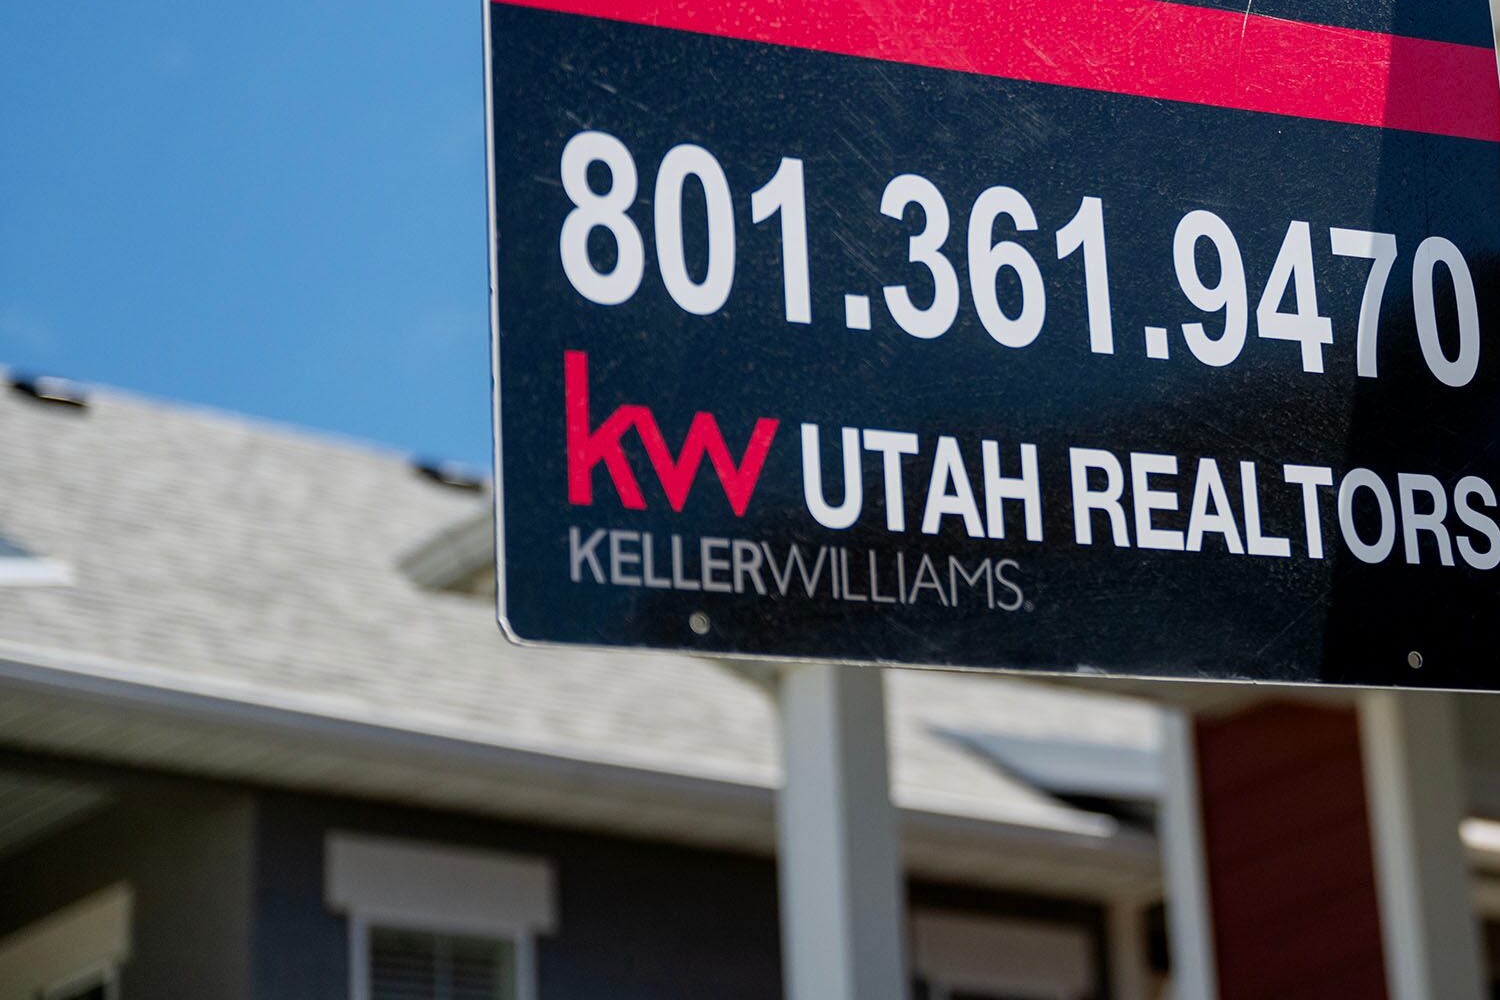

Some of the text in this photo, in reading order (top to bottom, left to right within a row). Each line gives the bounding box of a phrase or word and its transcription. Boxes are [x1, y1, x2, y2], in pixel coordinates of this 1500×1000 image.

[559, 130, 1480, 388] 801.361.9470
[564, 350, 779, 517] kw
[800, 422, 1044, 542] UTAH
